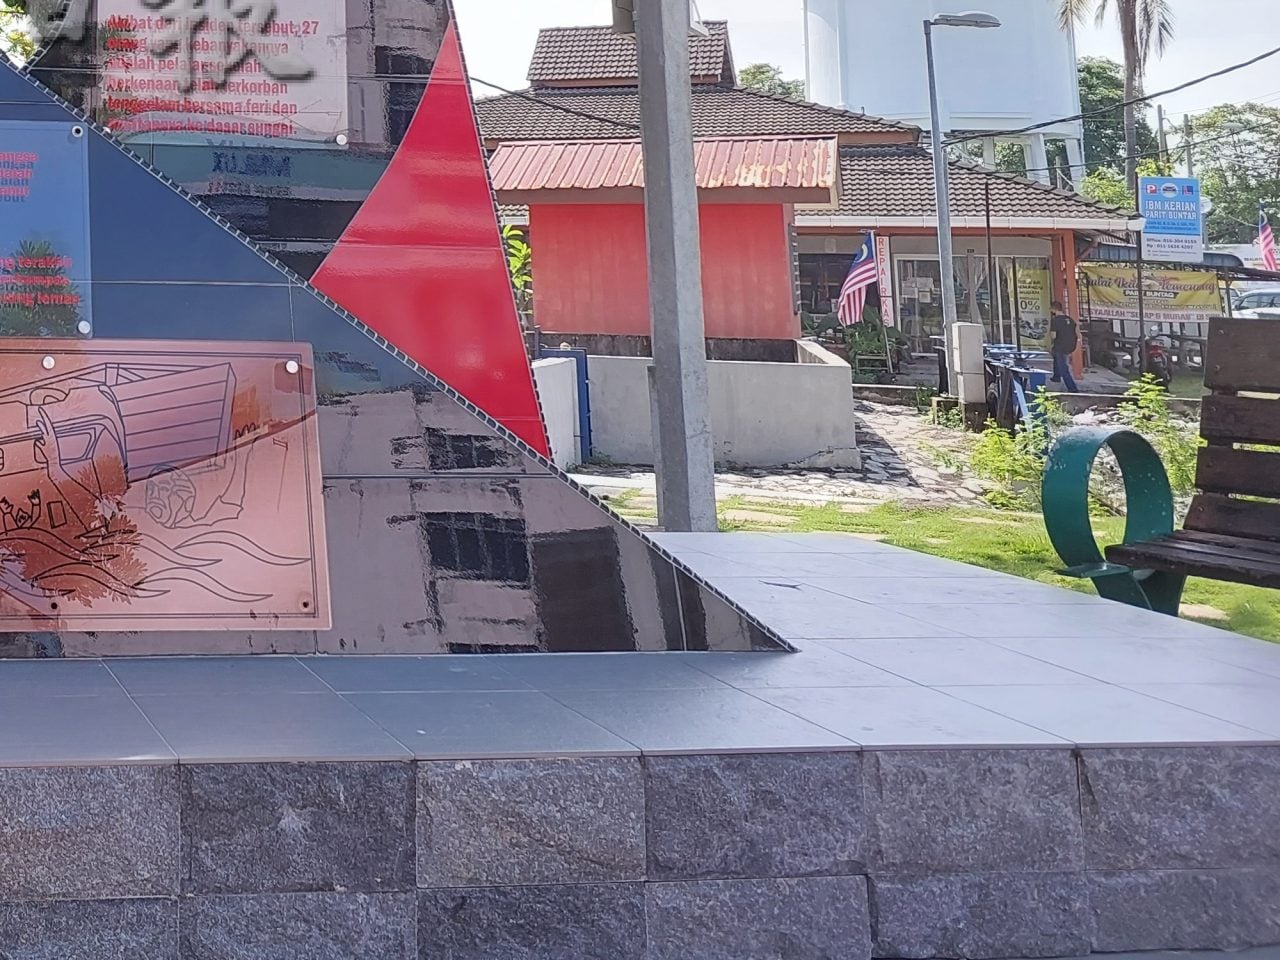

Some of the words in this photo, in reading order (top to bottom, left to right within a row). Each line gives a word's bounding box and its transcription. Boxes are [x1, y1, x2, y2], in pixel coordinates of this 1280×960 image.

[302, 21, 319, 34] 27
[184, 79, 218, 92] elah
[222, 79, 288, 94] erkorban
[245, 99, 269, 113] feri
[272, 100, 297, 114] dan
[1145, 201, 1161, 210] IBM
[1164, 202, 1196, 211] KERIAN
[1146, 211, 1166, 219] PARIT
[1168, 212, 1197, 220] BUNTAR
[878, 238, 887, 296] REPAIR
[1020, 300, 1040, 311] 0%
